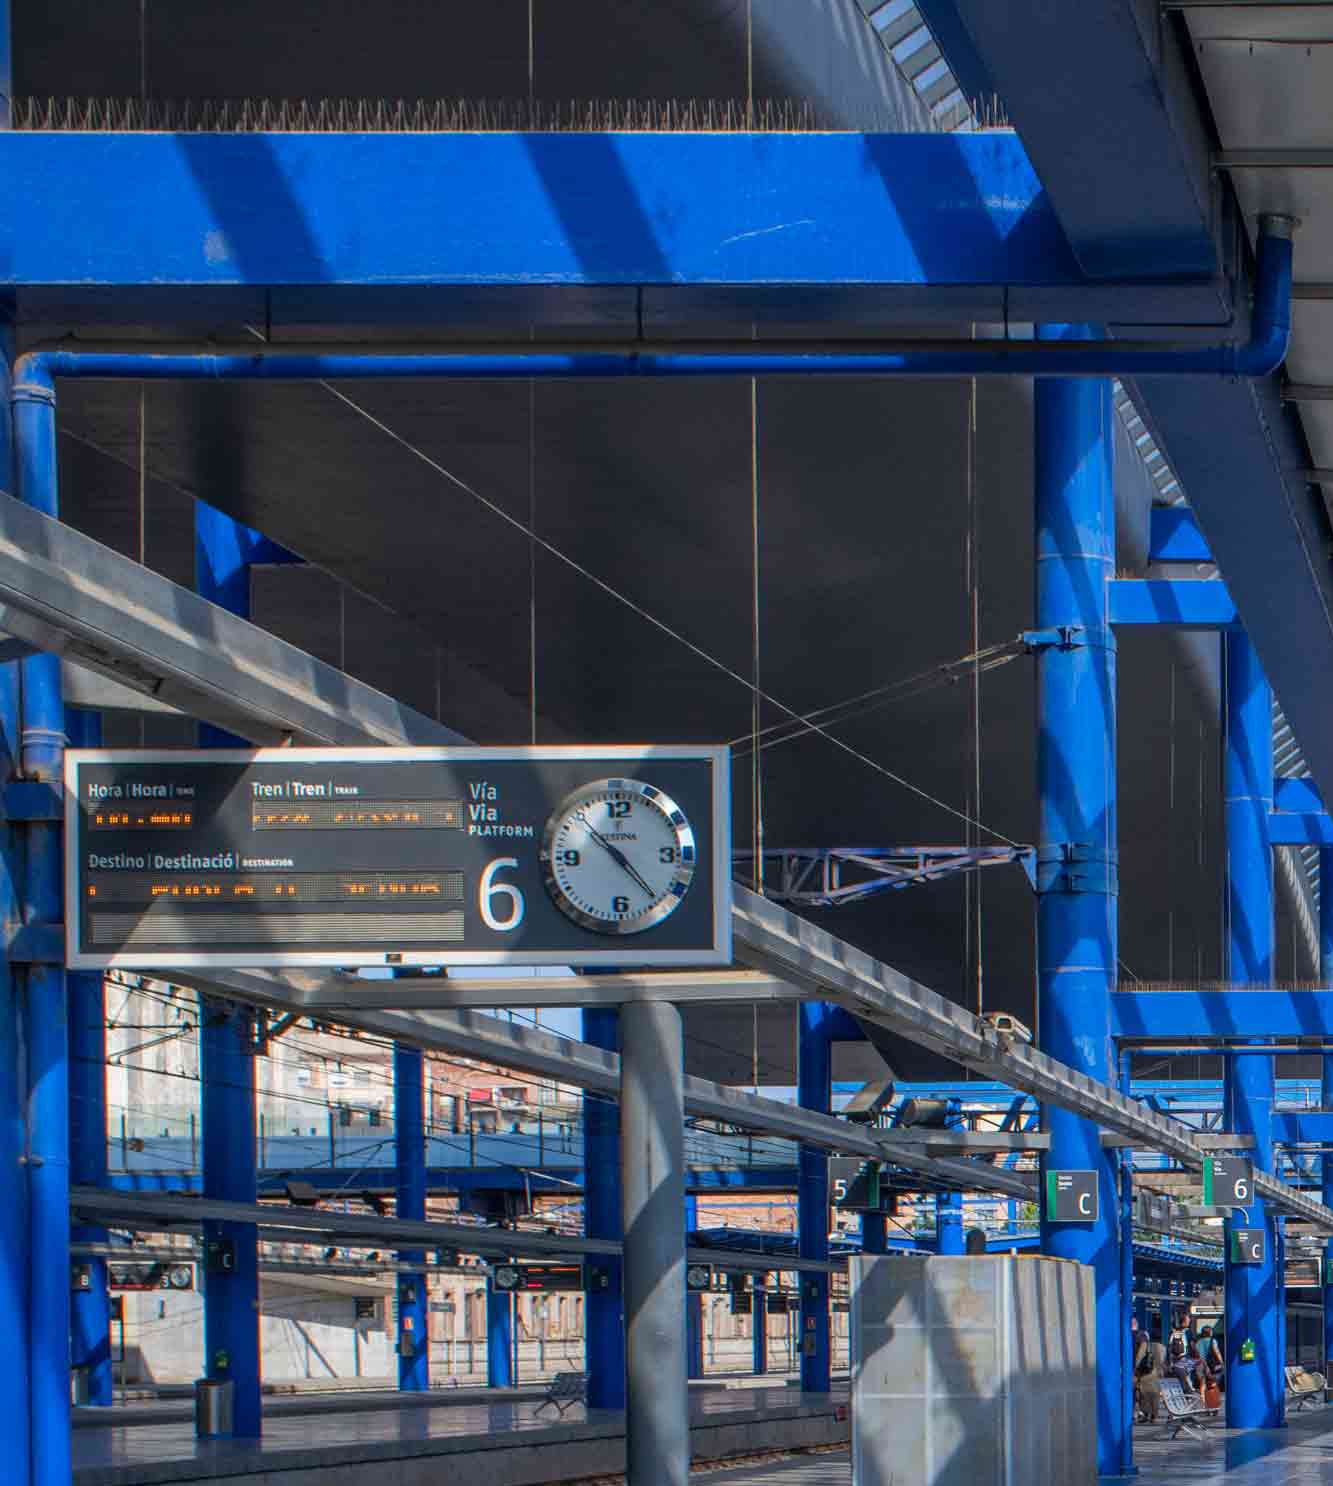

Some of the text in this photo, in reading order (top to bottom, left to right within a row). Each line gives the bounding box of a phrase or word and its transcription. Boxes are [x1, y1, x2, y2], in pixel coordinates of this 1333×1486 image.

[88, 783, 122, 797] Hora
[131, 783, 168, 797] Hora
[252, 782, 284, 796] Tren
[292, 782, 326, 796] Tren
[469, 781, 497, 800] Vía
[469, 803, 497, 820] Via
[606, 801, 632, 818] 12
[468, 825, 534, 837] PLATFORM
[88, 854, 144, 868] Destino
[154, 852, 233, 868] Destinació
[563, 850, 581, 867] 9
[658, 847, 676, 864] 3
[478, 857, 527, 932] 6
[613, 895, 630, 913] 6
[834, 1179, 848, 1201] 5
[1234, 1178, 1248, 1199] 6
[1079, 1192, 1091, 1215] C
[1252, 1243, 1261, 1259] C
